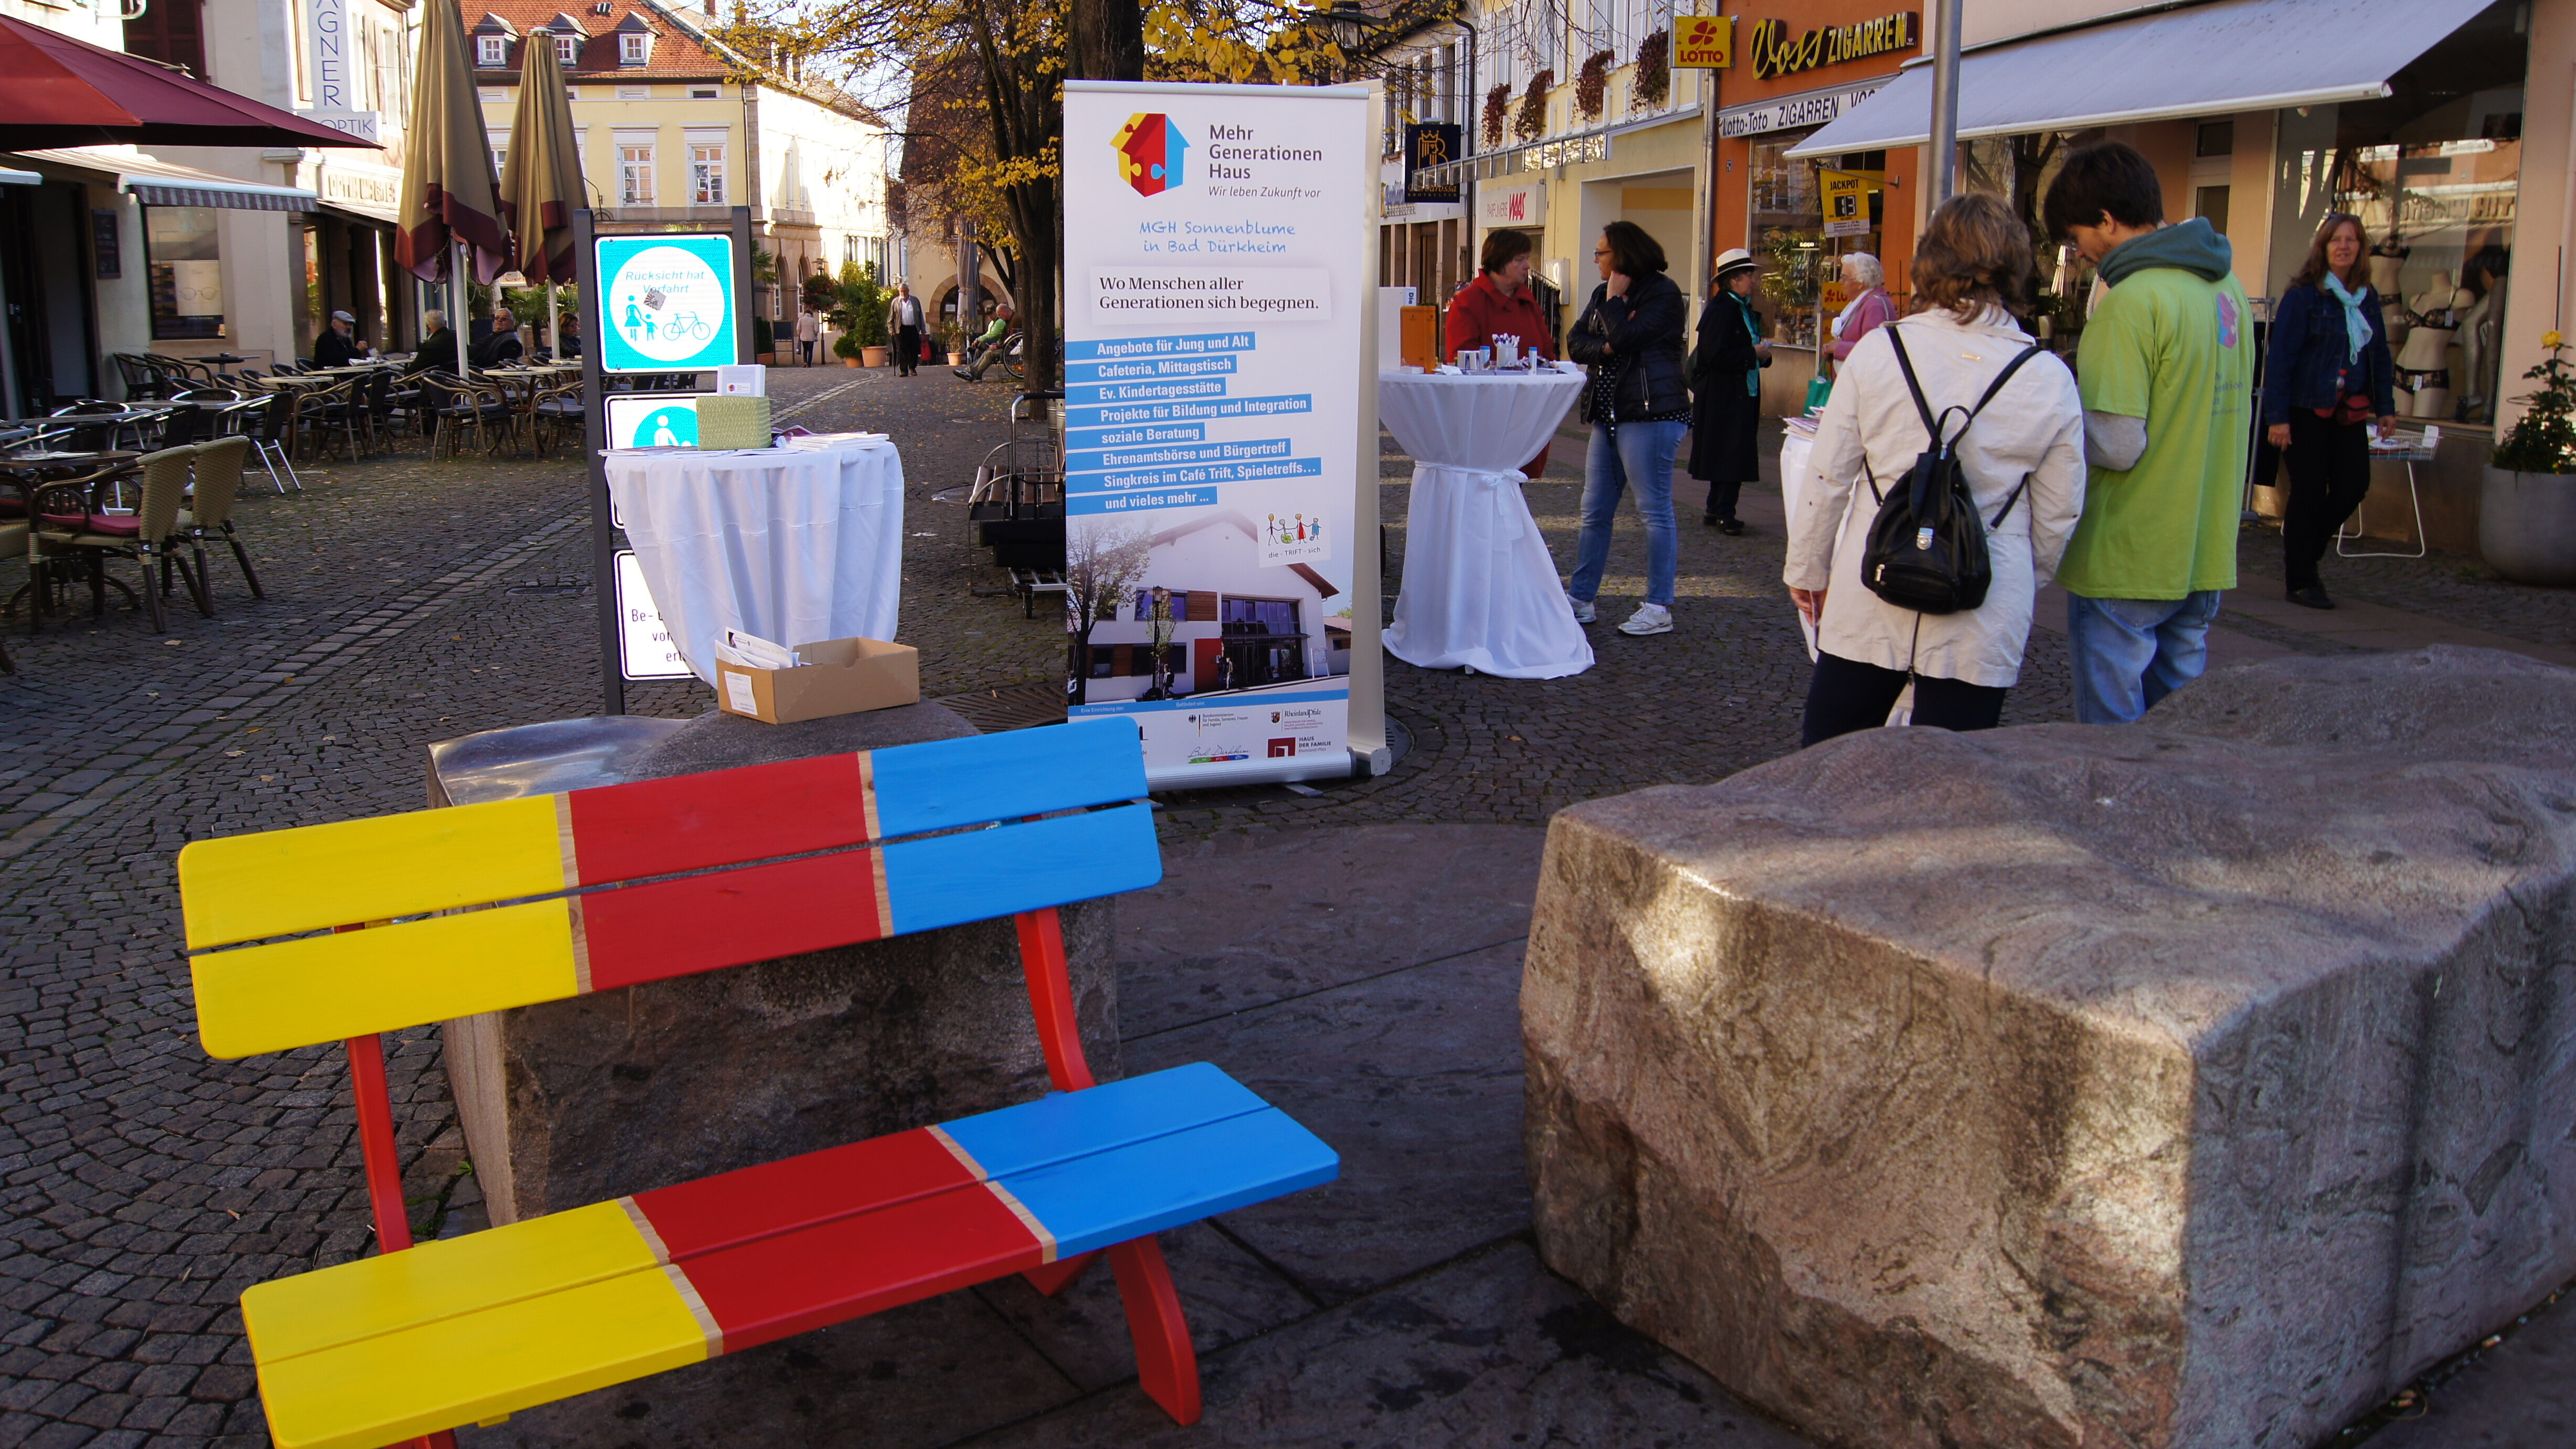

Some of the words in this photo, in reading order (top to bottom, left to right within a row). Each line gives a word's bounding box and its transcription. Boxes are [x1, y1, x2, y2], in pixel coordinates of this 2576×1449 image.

[1750, 18, 1827, 79] Voss
[1827, 13, 1907, 63] ZIGARREN
[1680, 50, 1724, 62] LOTTO
[1722, 112, 1768, 136] Lotto-Toto
[1778, 96, 1840, 126] ZIGARREN
[1210, 124, 1254, 140] Mehr
[1209, 144, 1322, 161] Generationen
[1210, 164, 1251, 179] Haus
[1209, 186, 1227, 196] Wir
[1230, 186, 1257, 197] leben
[1260, 187, 1302, 199] Zukunft
[1305, 189, 1321, 198] vor
[1830, 179, 1859, 190] JACKPOT
[1139, 221, 1177, 235] MGH
[1184, 220, 1296, 235] Sonnenblume
[1143, 240, 1160, 252] in
[1168, 239, 1200, 253] Bad
[1207, 240, 1287, 253] Dürkheim
[626, 271, 683, 280] Rücksicht
[687, 270, 704, 279] hat
[1099, 276, 1125, 290] Wo
[1129, 276, 1206, 291] Menschen
[1209, 277, 1244, 291] aller
[1099, 295, 1204, 310] Generationen
[1207, 296, 1236, 309] sich
[1239, 296, 1319, 312] begegnen.
[1097, 343, 1153, 356] Angebote
[1156, 341, 1173, 352] für
[1175, 339, 1205, 353] Jung
[1208, 337, 1229, 349] und
[1232, 335, 1249, 347] Alt
[1098, 364, 1156, 378] Cafeteria,
[1158, 358, 1231, 375] Mittagstisch
[1099, 388, 1116, 399] Ev.
[1119, 382, 1221, 398] Kindertagesstätte
[1101, 409, 1150, 423] Projekte
[1152, 406, 1169, 418] für
[1173, 404, 1217, 418] Bildung
[1220, 402, 1241, 413] und
[1244, 398, 1307, 413] Integration
[1102, 430, 1143, 443] soziale
[1146, 427, 1200, 441] Beratung
[1103, 449, 1196, 465] Ehrenamtsbörse
[1200, 446, 1220, 457] und
[1223, 442, 1286, 458] Bürgertreff
[1104, 473, 1159, 488] Singkreis
[1162, 472, 1177, 483] im
[1180, 468, 1205, 481] Café
[1209, 467, 1235, 480] Trift,
[1105, 497, 1126, 508] und
[1129, 494, 1164, 506] vieles
[1167, 492, 1197, 504] mehr
